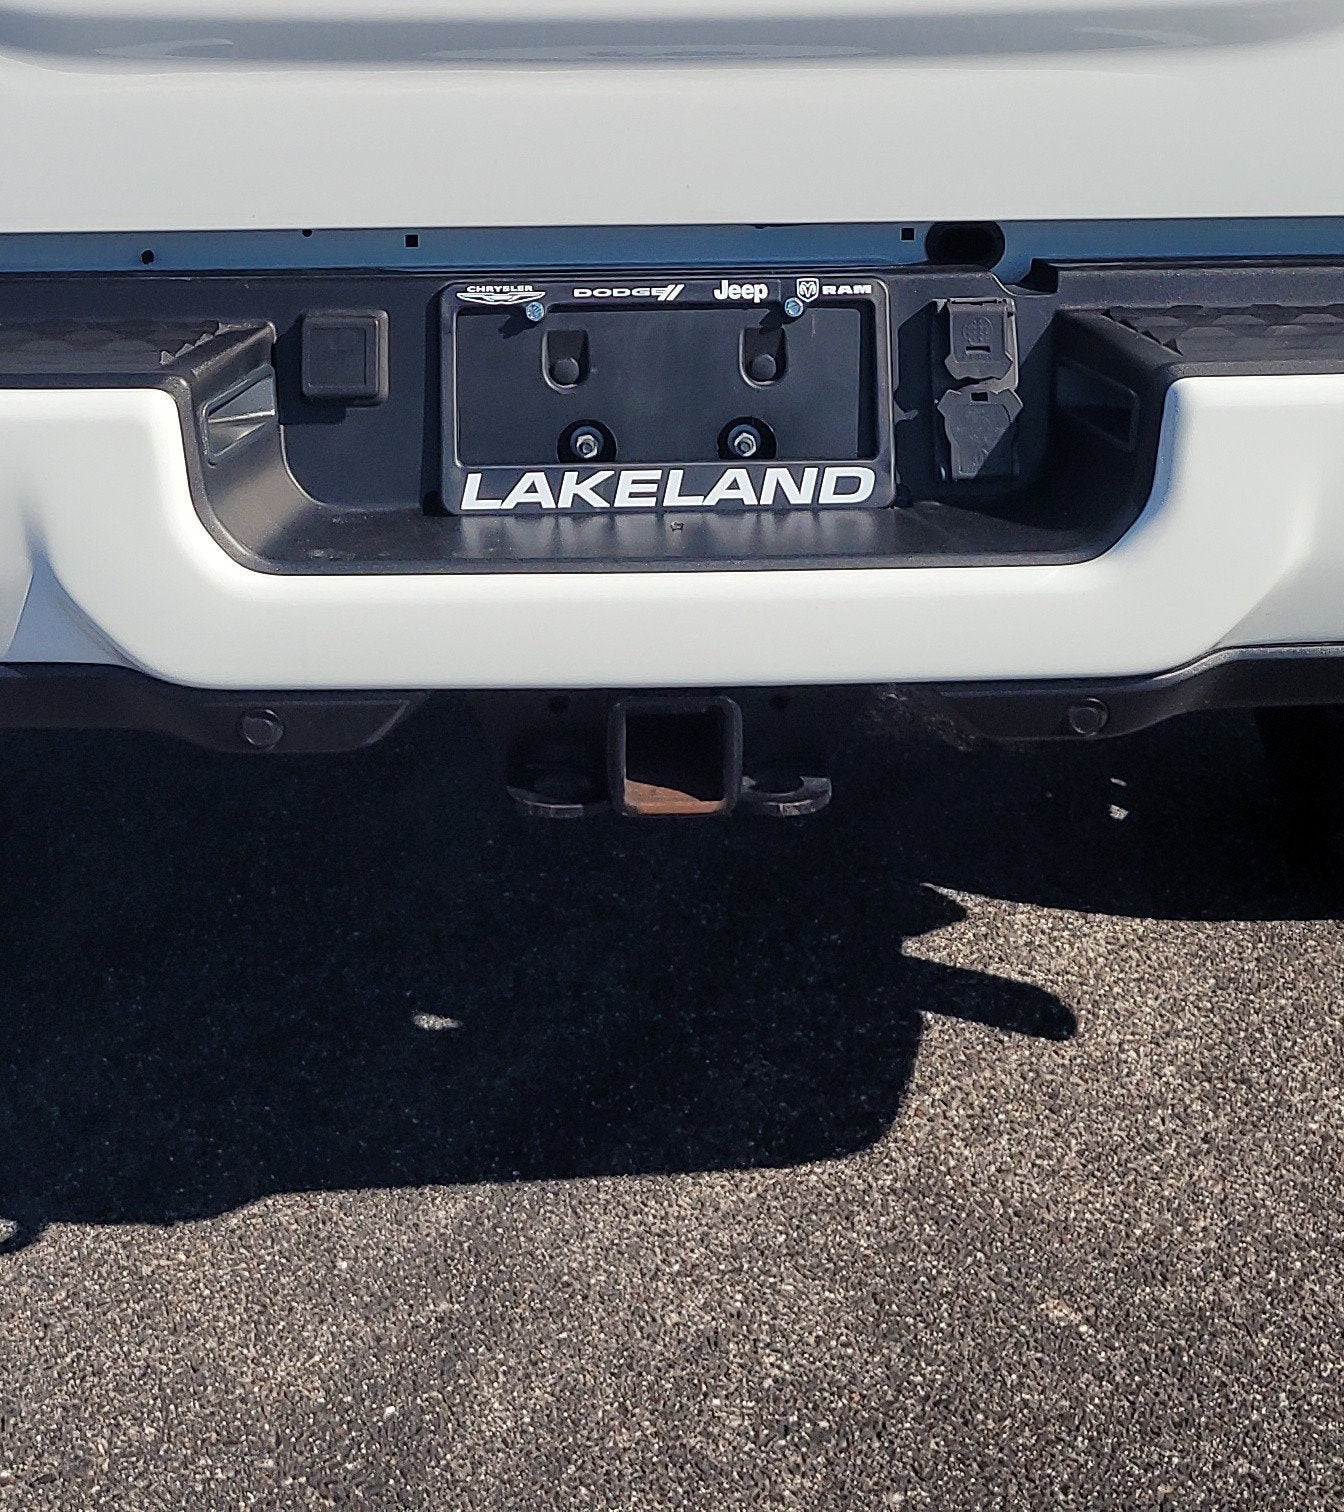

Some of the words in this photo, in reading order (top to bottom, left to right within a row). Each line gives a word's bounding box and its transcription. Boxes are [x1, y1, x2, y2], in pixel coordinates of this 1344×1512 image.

[466, 284, 533, 293] CHRYSLER
[573, 288, 667, 298] DODGE
[714, 279, 768, 303] Jeep
[822, 284, 871, 295] RAM
[461, 467, 875, 510] LAKELAND
